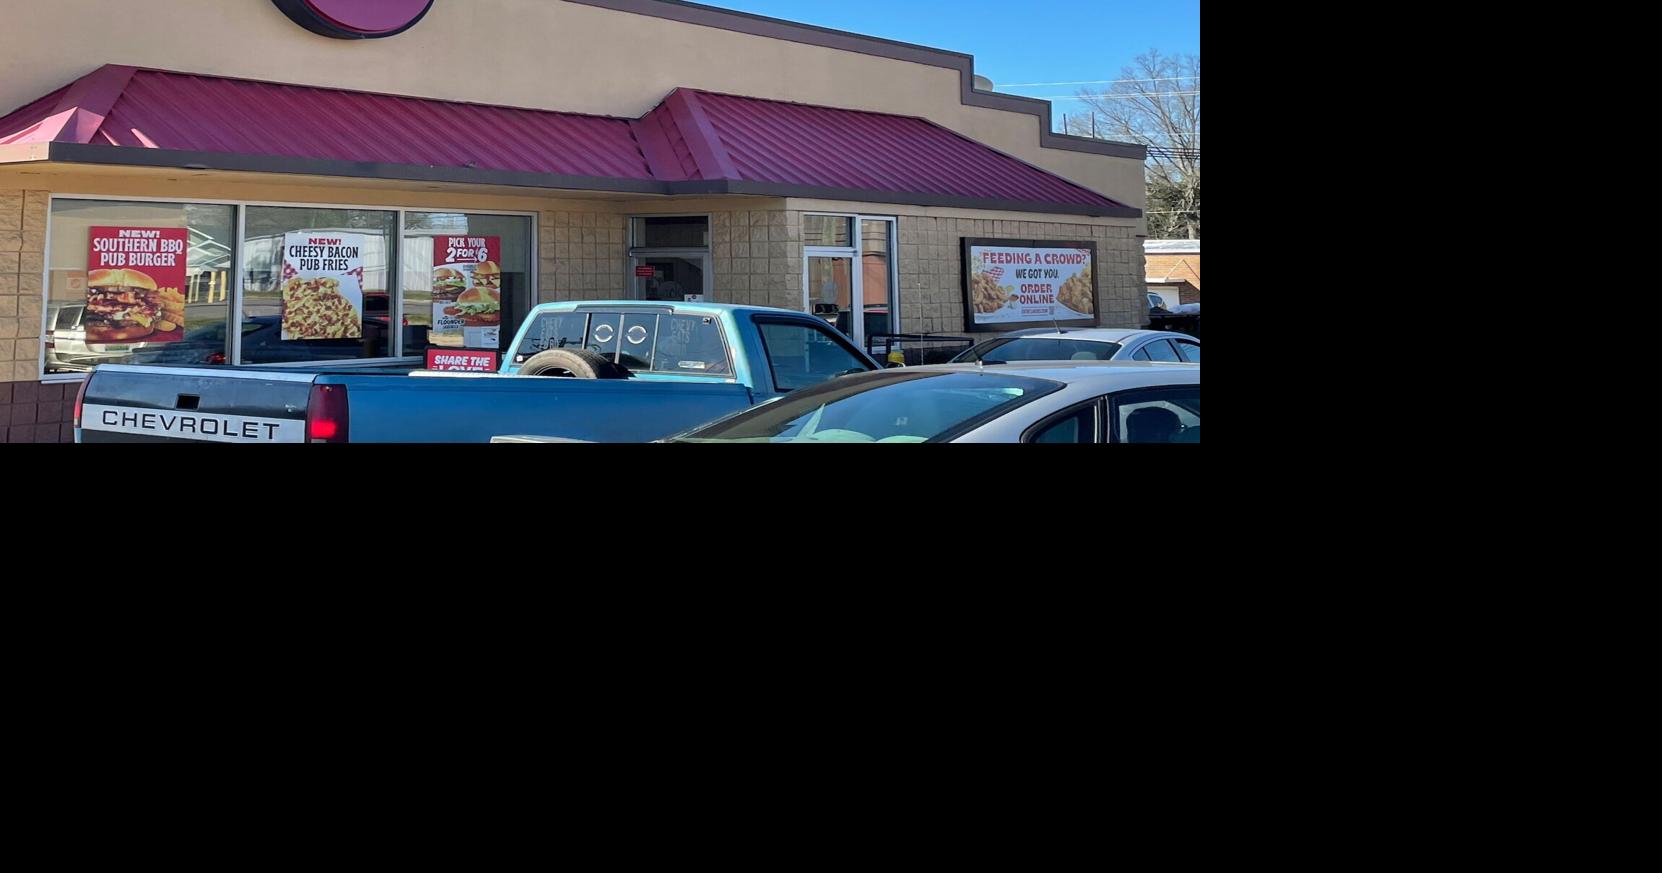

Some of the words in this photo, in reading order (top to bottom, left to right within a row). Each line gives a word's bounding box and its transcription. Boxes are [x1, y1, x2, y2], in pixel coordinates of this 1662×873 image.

[119, 230, 160, 238] NEW!
[93, 238, 156, 252] SOUTHERN
[160, 239, 183, 254] BBQ
[448, 237, 465, 247] PICK
[467, 238, 486, 248] YOUR
[289, 245, 325, 258] CHEESY
[327, 246, 359, 258] BACON
[445, 247, 456, 263] 2
[456, 248, 474, 257] FOR
[100, 253, 126, 266] PUB
[128, 253, 175, 266] BURGER
[982, 252, 1032, 264] FEEDING
[1034, 253, 1041, 264] A
[1044, 253, 1086, 265] CROWD?
[300, 259, 320, 271] PUB
[322, 259, 349, 271] FRIES
[1015, 268, 1026, 279] WE
[1027, 269, 1042, 279] GOT
[1020, 283, 1053, 294] ORDER
[1019, 294, 1055, 305] ONLINE
[434, 355, 468, 366] SHARE
[470, 356, 491, 367] THE
[102, 410, 280, 440] CHEVROLET
